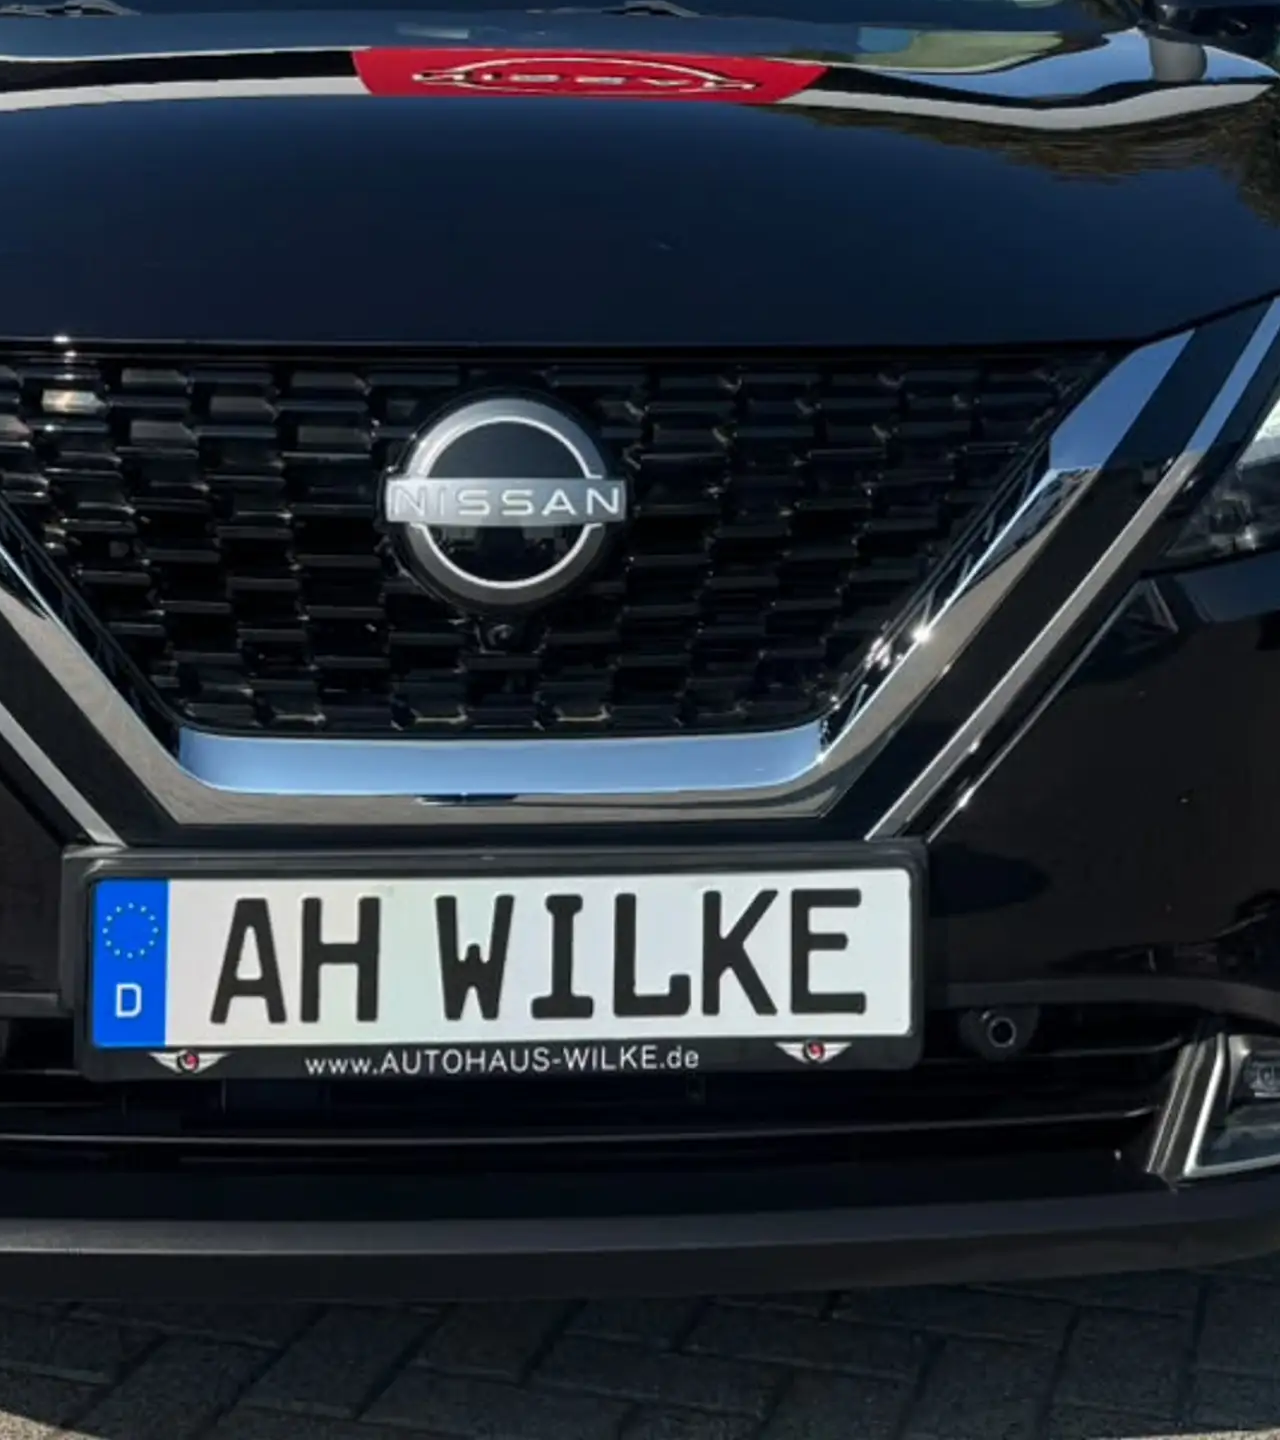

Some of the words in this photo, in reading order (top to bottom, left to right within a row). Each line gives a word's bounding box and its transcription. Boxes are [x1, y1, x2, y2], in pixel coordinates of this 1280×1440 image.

[391, 484, 621, 517] NISSAN
[210, 896, 381, 1024] AH
[435, 888, 867, 1021] WILKE
[115, 983, 142, 1018] D
[305, 1044, 699, 1076] www.AUTOHAUS-WILKE.de
